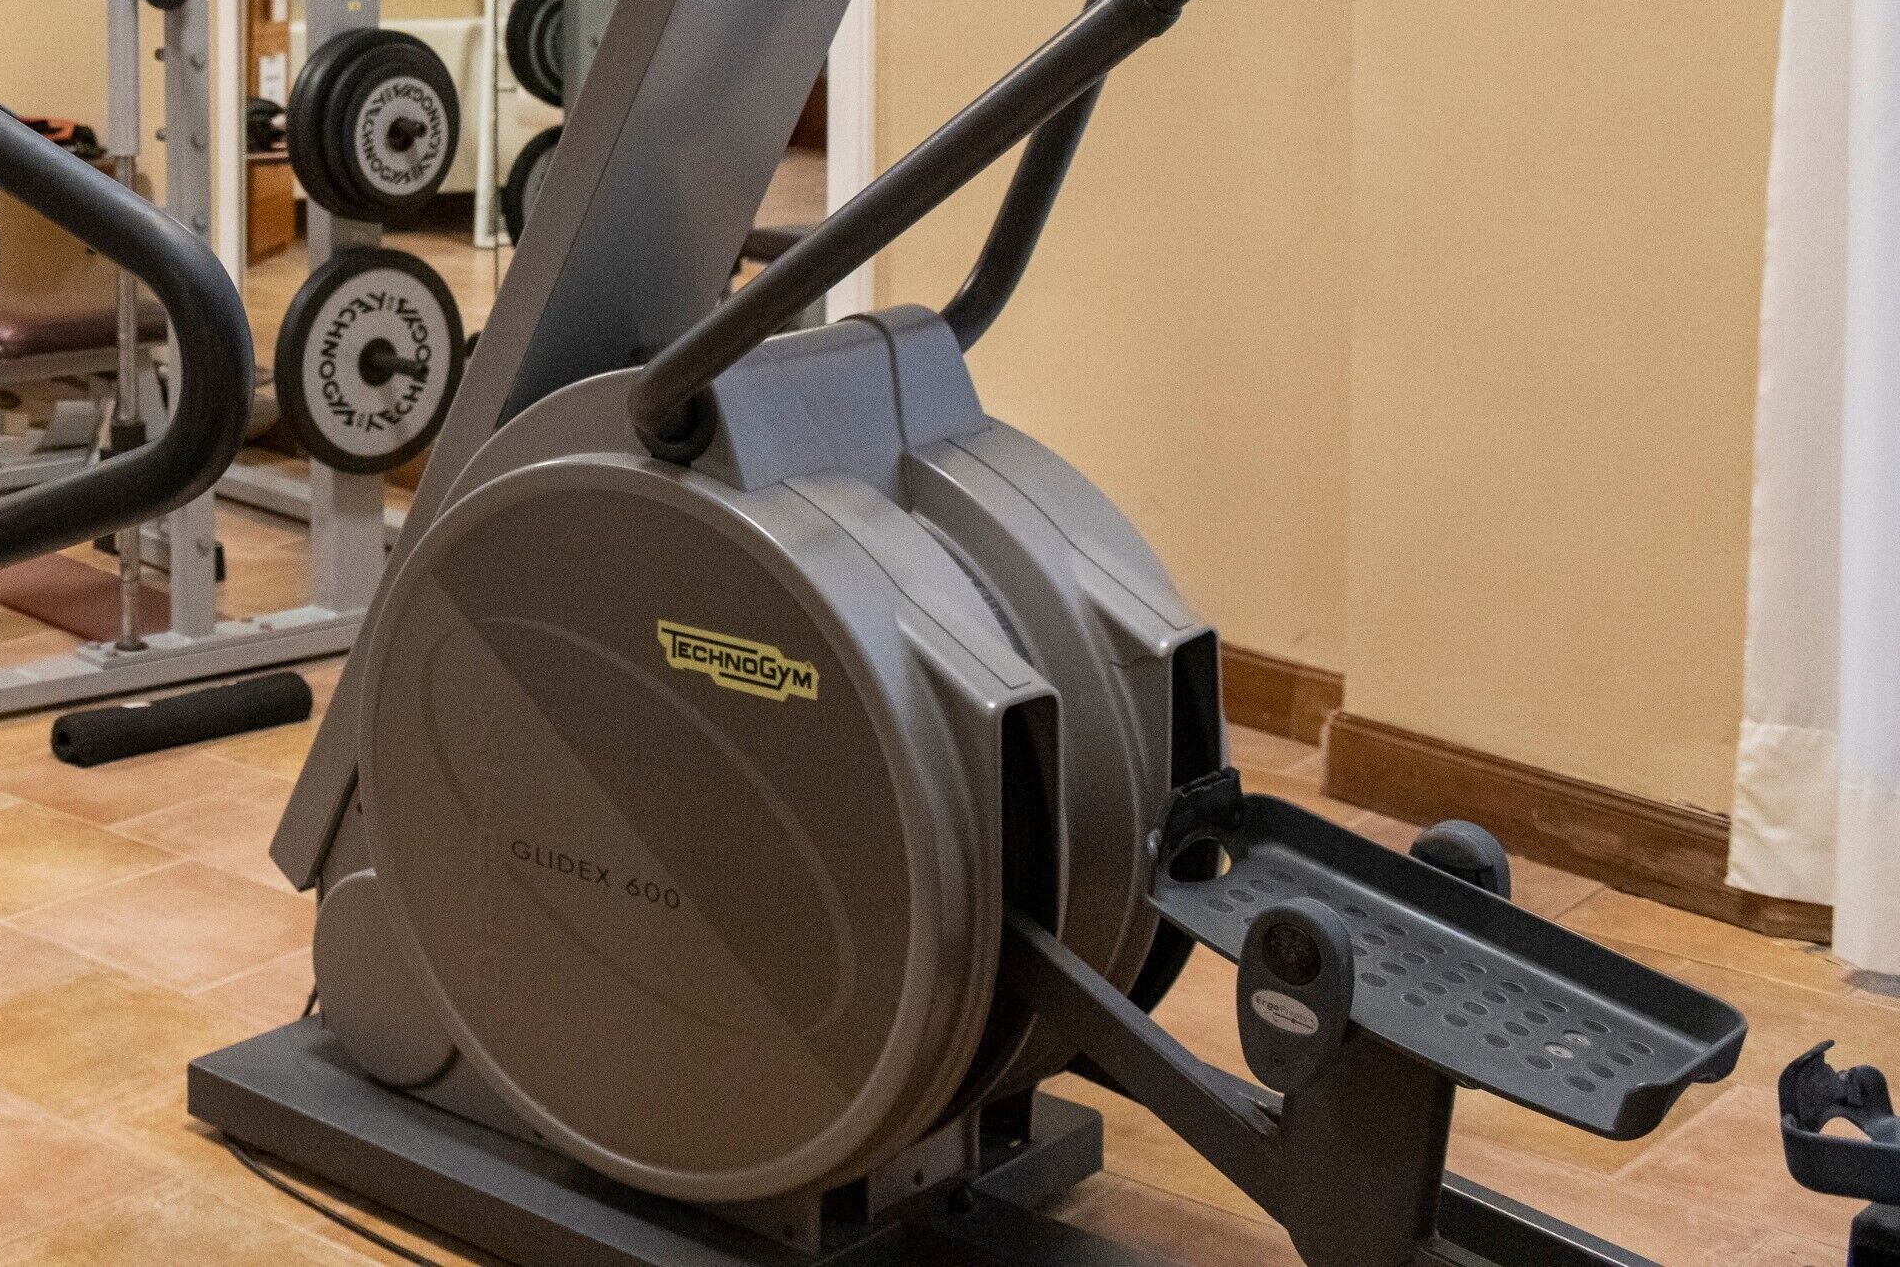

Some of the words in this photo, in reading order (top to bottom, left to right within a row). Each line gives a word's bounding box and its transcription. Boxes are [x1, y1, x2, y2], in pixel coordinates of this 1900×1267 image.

[660, 626, 814, 691] TECHNOGYM
[511, 839, 611, 888] GLIDEX
[625, 877, 681, 909] 600
